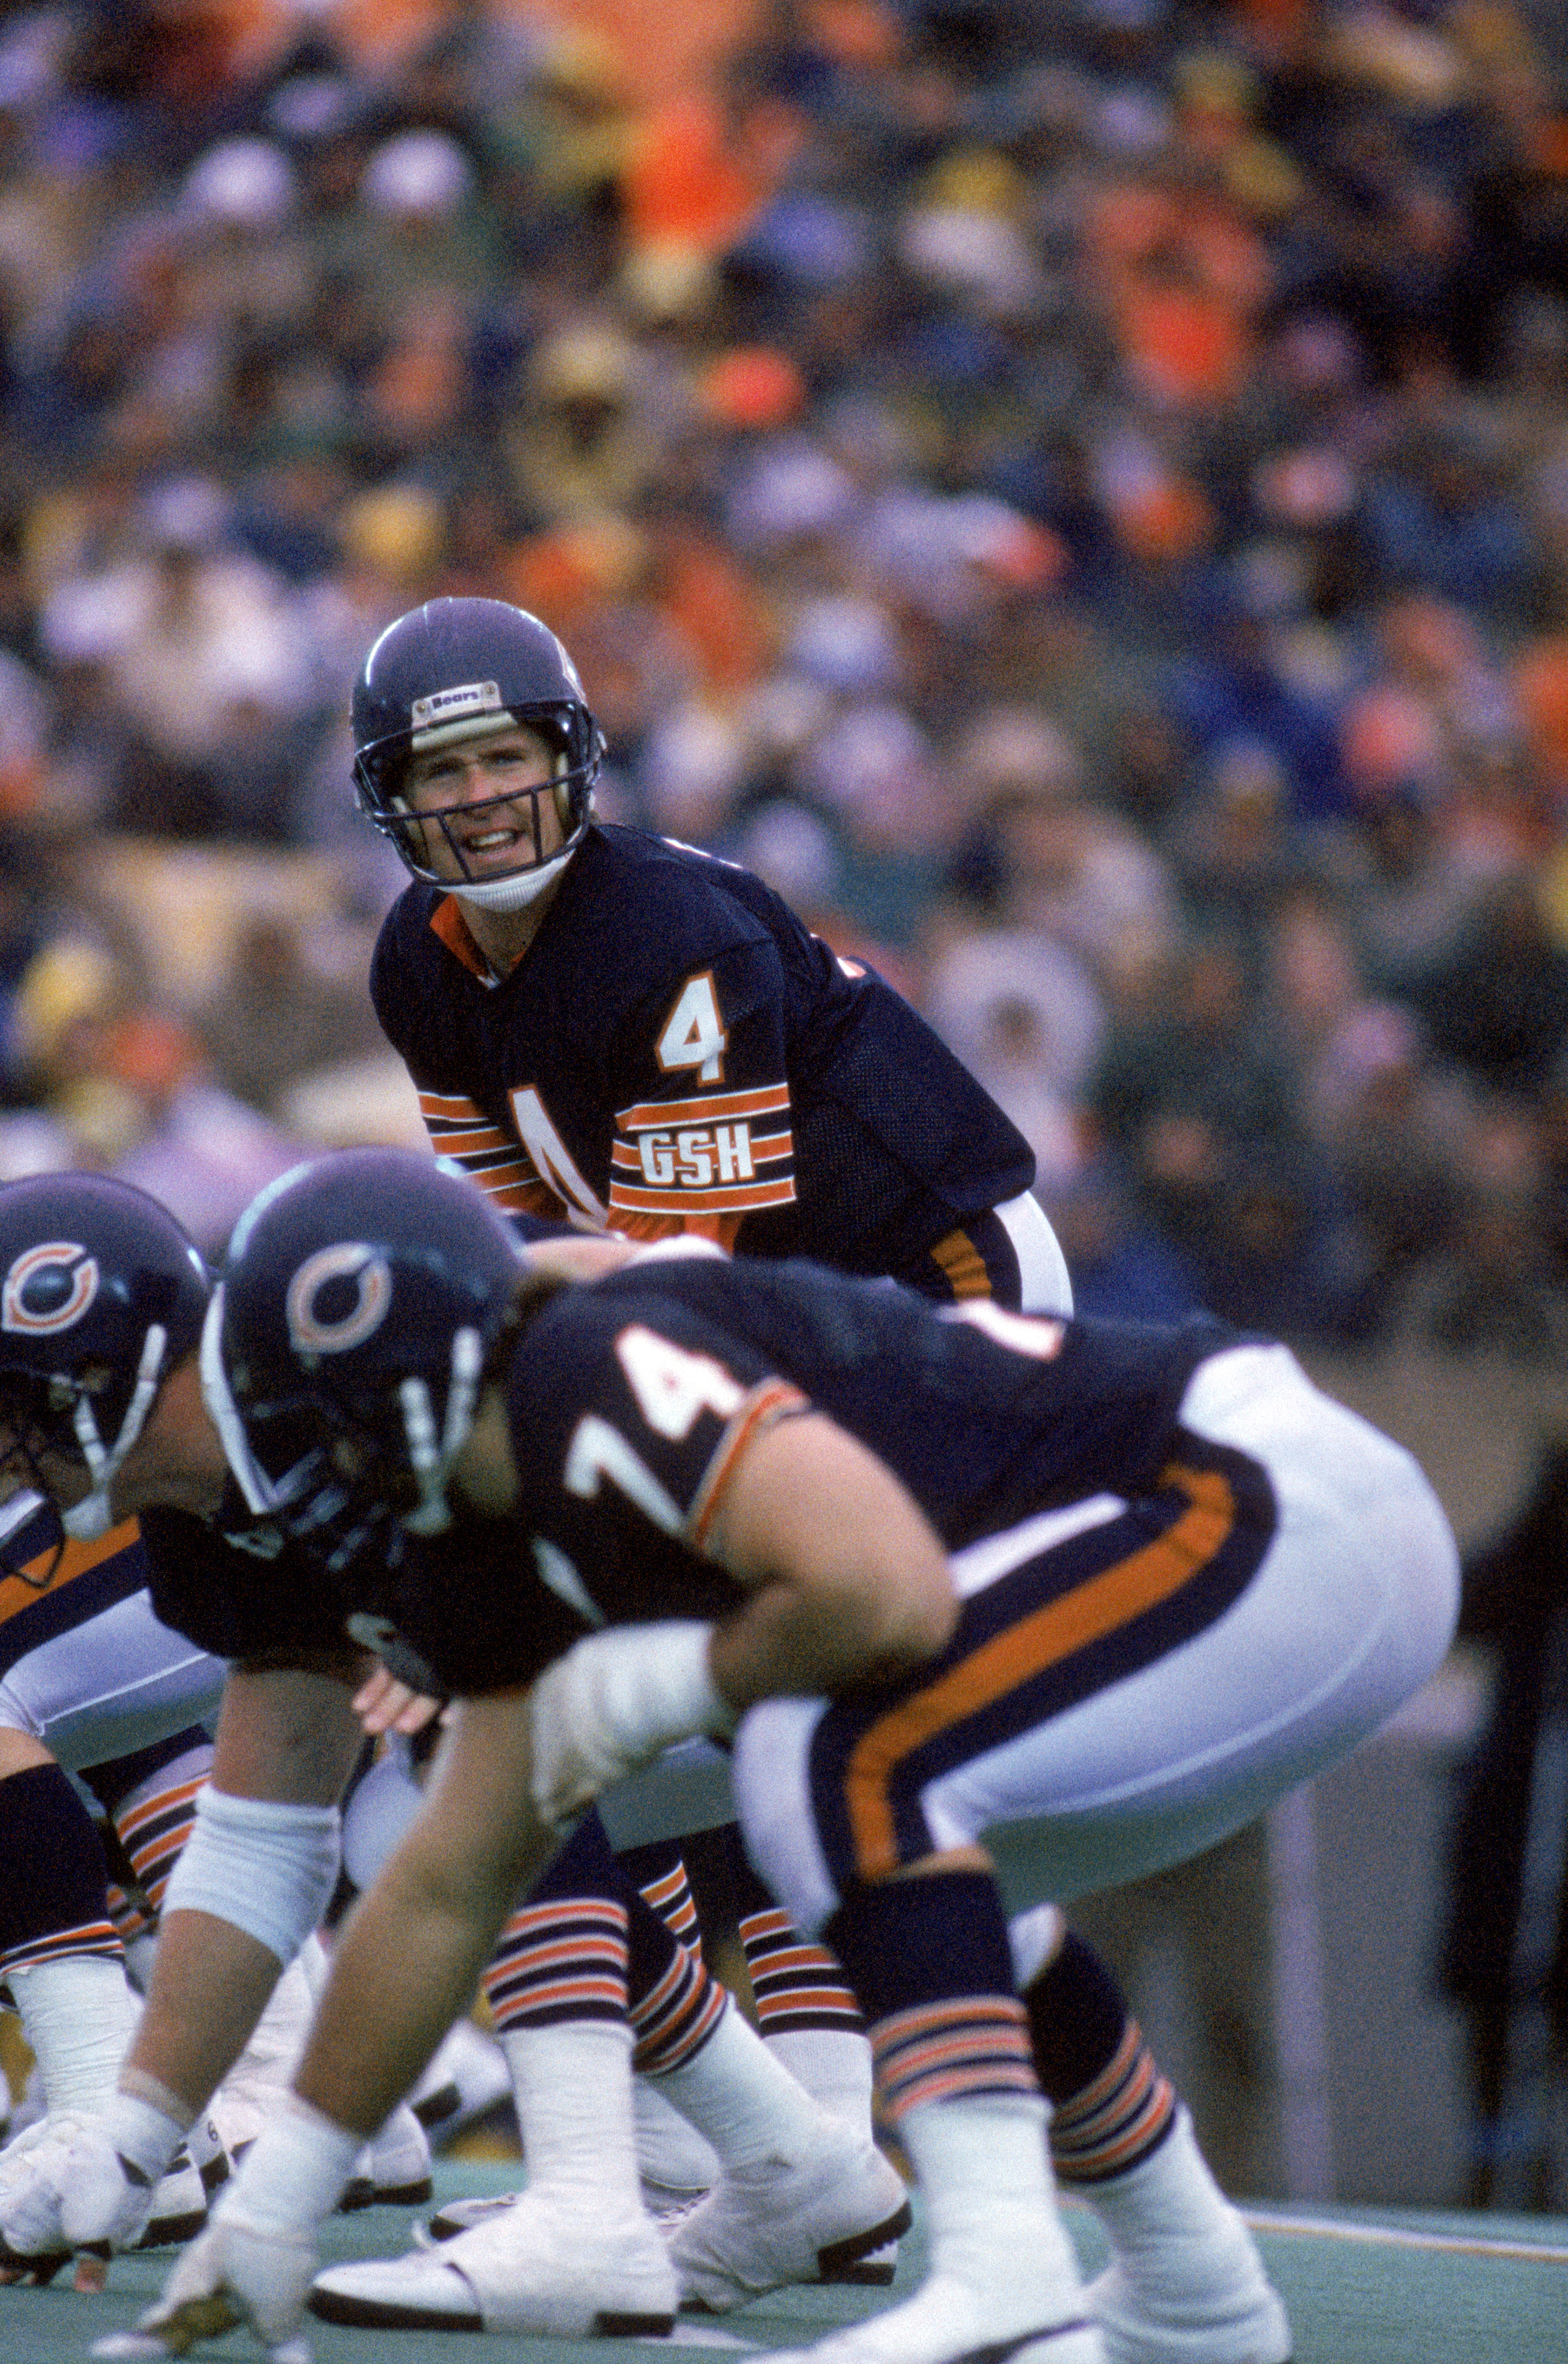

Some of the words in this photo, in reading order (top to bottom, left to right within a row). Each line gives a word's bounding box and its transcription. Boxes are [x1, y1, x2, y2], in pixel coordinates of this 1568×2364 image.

[431, 691, 478, 709] Bears
[654, 970, 728, 1087] 4
[638, 1122, 756, 1186] GSH
